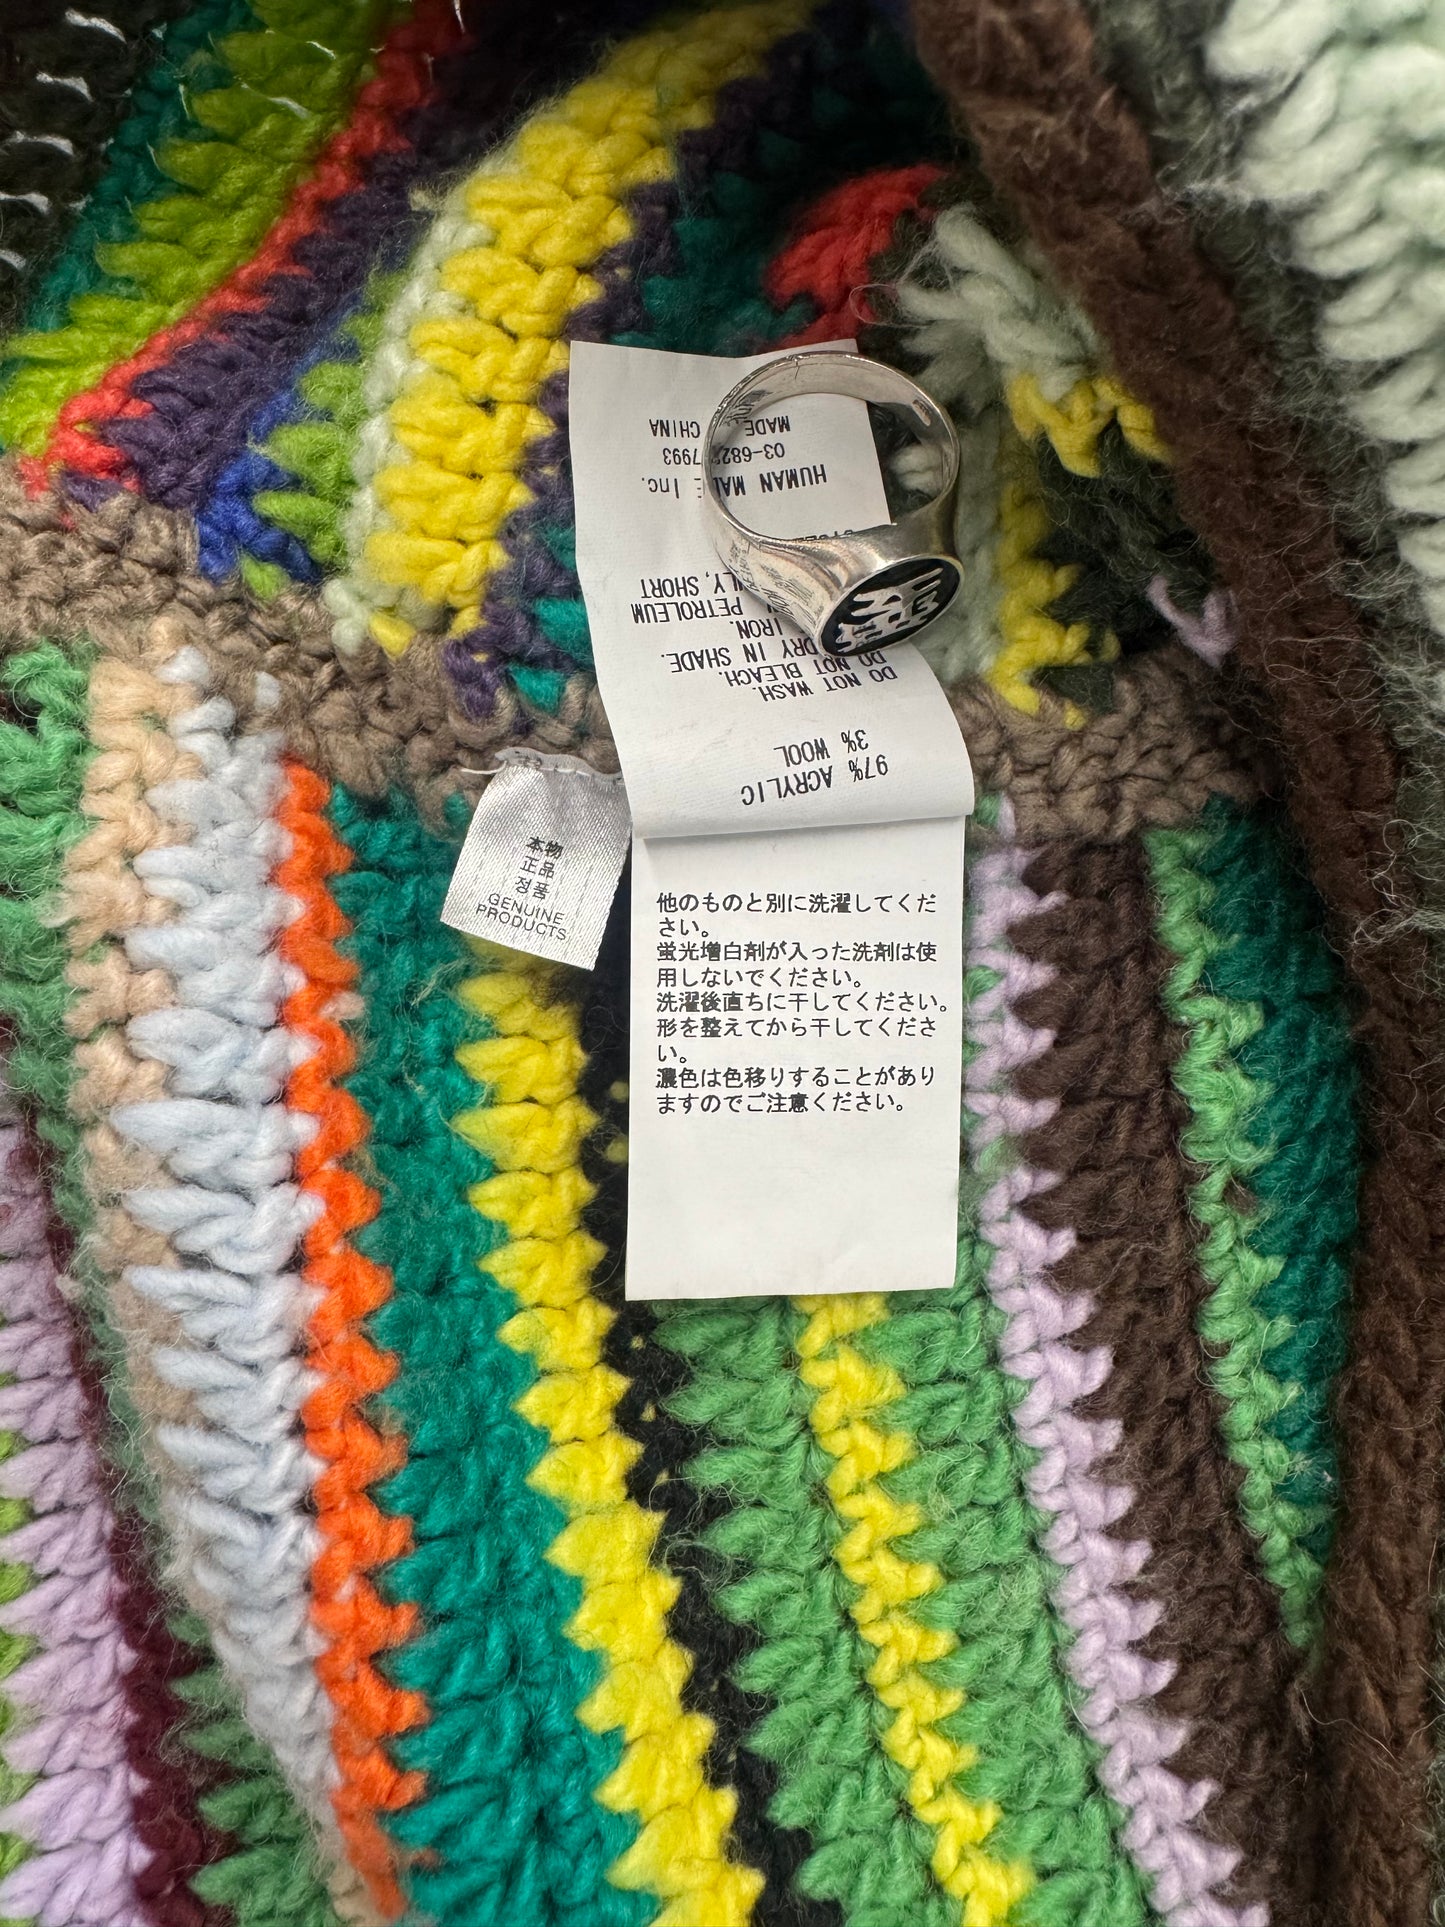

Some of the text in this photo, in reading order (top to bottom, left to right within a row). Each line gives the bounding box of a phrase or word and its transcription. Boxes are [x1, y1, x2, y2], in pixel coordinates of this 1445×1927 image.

[649, 416, 791, 438] MADE CHINA
[662, 443, 785, 465] 03-6827993
[641, 477, 680, 499] Inc.
[759, 464, 827, 493] HUMAN
[640, 575, 699, 599] SHORT
[631, 597, 743, 624] PETROLEUM
[730, 618, 783, 640] IRON.
[661, 636, 820, 673] DRY IN SHADE.
[718, 662, 803, 687] BLEACH.
[816, 657, 851, 676] NOT
[752, 666, 898, 701] DO NOT WASH.
[773, 729, 869, 767] 3% WOOL
[740, 754, 889, 806] 97% ACRYLIC
[526, 836, 564, 860] 本物
[519, 856, 555, 879] 正品
[515, 876, 550, 900] 정품
[488, 893, 565, 925] GENUINE
[656, 892, 936, 913] 他のものと別に洗濯してくだ
[475, 903, 567, 940] PRODUCTS
[658, 917, 709, 938] さい。
[656, 941, 937, 962] 蛍光増白剤が入った洗剤は使
[656, 966, 861, 988] 用しないでください。
[656, 991, 948, 1012] 洗濯後直ちに干してください。
[656, 1017, 936, 1038] 形を整えてから干してくださ
[656, 1044, 687, 1064] い。
[655, 1066, 935, 1089] 濃色は色移りすることがあり
[656, 1092, 903, 1114] ますのでご注意ください。
